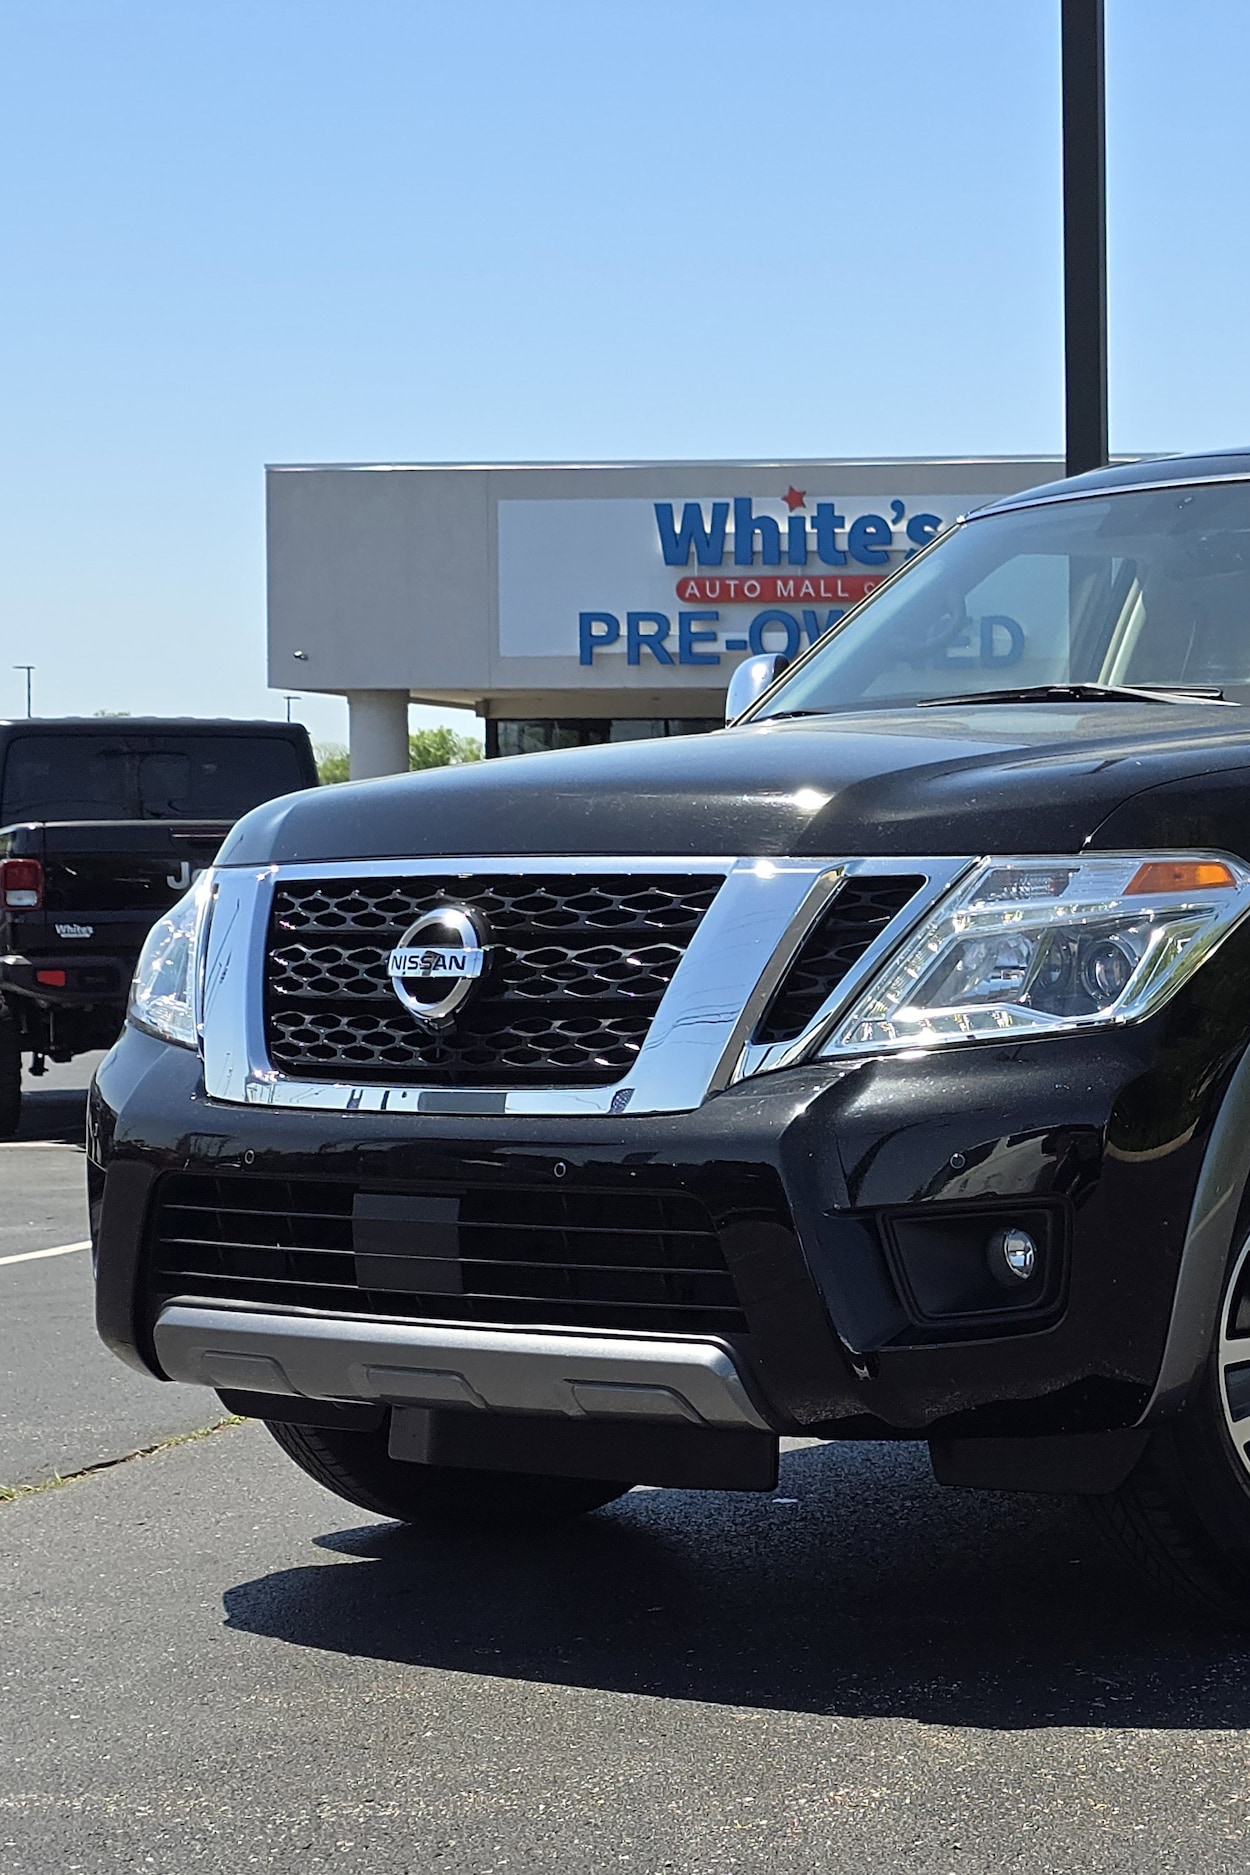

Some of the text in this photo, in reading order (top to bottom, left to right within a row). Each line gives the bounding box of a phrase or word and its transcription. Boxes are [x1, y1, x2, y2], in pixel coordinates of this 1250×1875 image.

[654, 497, 943, 567] White's
[684, 580, 761, 598] AUTO
[777, 579, 849, 597] MALL
[391, 955, 466, 971] NISSAN
